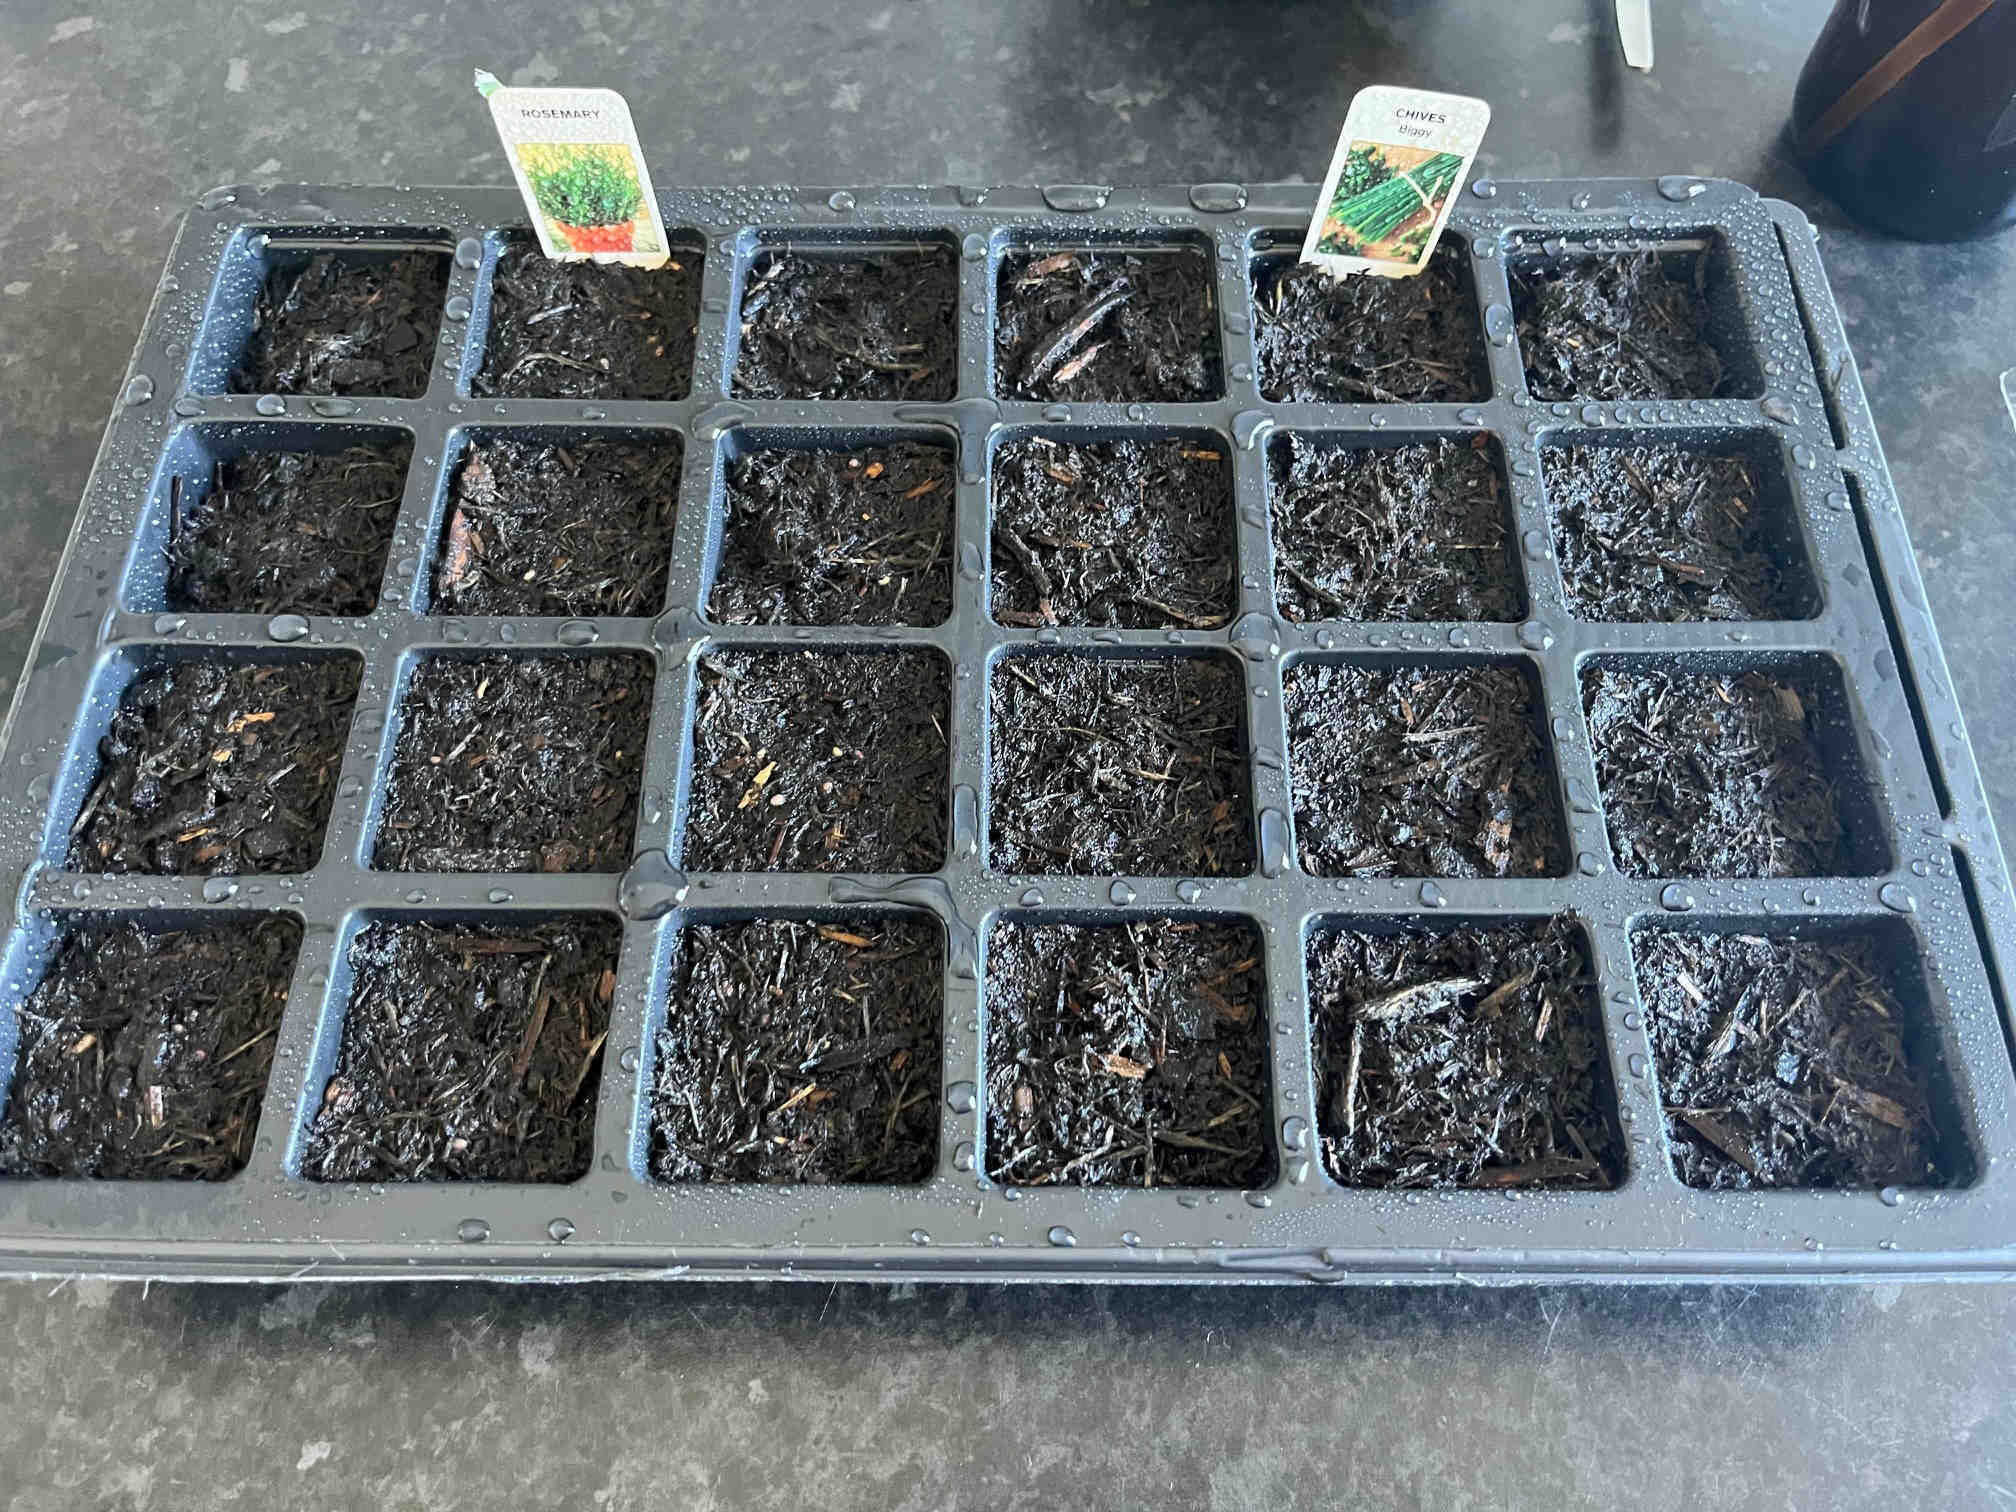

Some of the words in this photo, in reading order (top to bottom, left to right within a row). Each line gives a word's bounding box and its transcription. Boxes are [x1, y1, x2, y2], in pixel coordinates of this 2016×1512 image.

[521, 109, 600, 119] ROSEMARY
[1396, 108, 1447, 124] CHIVES
[1399, 124, 1432, 137] Biggy
